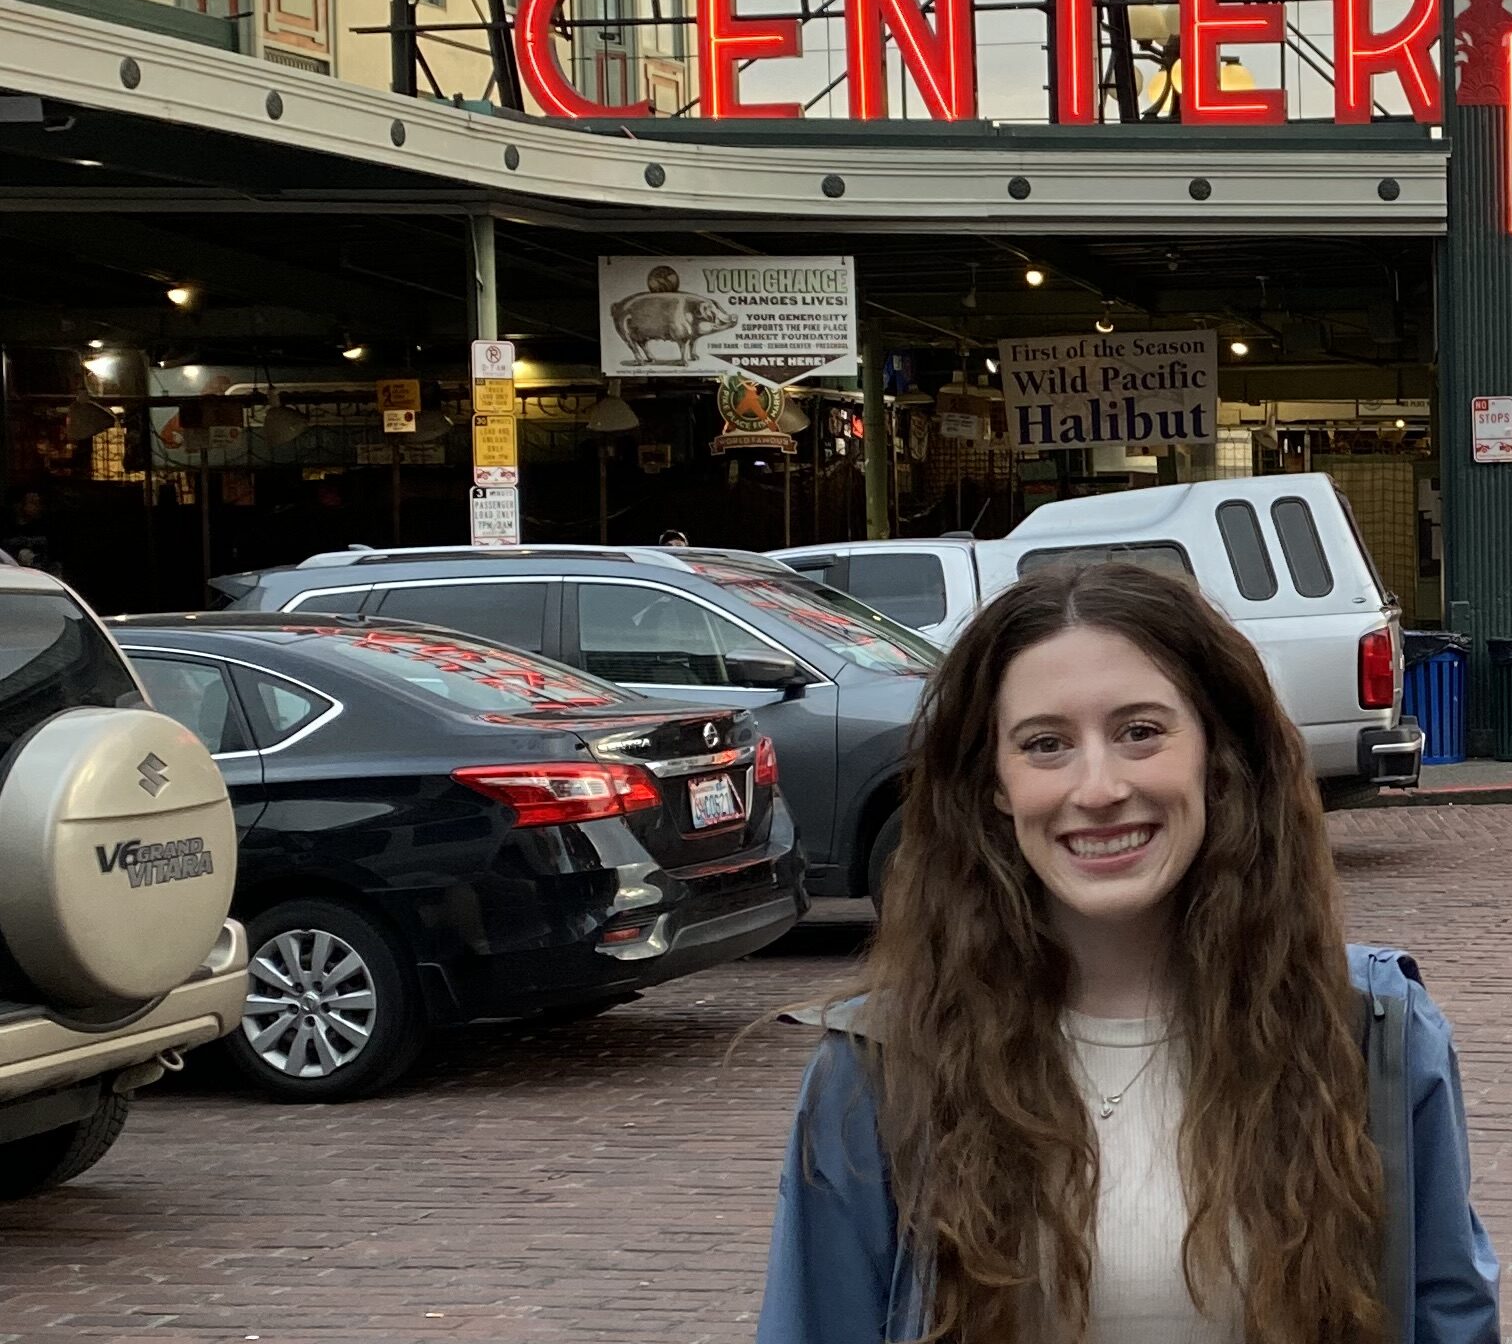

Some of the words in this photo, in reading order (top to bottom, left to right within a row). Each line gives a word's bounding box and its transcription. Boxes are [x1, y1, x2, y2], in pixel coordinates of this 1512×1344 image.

[703, 268, 761, 294] YOUR
[763, 269, 848, 294] CHANGE
[728, 296, 798, 306] CHANGES
[802, 296, 848, 306] LIVES!
[746, 313, 776, 322] YOUR
[778, 313, 848, 322] GENEROSITY
[741, 323, 784, 332] SUPPORTS
[786, 323, 801, 332] THE
[803, 323, 820, 332] PIKE
[823, 323, 848, 332] PLACE
[735, 333, 779, 341] MARKET
[781, 333, 848, 341] FOUNDATION
[1011, 343, 1058, 362] First
[1066, 339, 1088, 360] of
[1093, 338, 1125, 358] the
[1132, 338, 1206, 357] Season
[731, 357, 784, 367] DONATE
[787, 357, 826, 367] HERE!
[1012, 365, 1088, 396] Wild
[1101, 360, 1208, 392] Pacific
[1475, 400, 1487, 410] NO
[475, 417, 487, 425] 30
[1015, 396, 1210, 445] Halibut
[1478, 413, 1510, 424] STOPS
[474, 500, 514, 509] PASSENGER
[95, 839, 141, 873] V6
[136, 837, 204, 863] GRAND
[127, 851, 214, 888] VITARA
